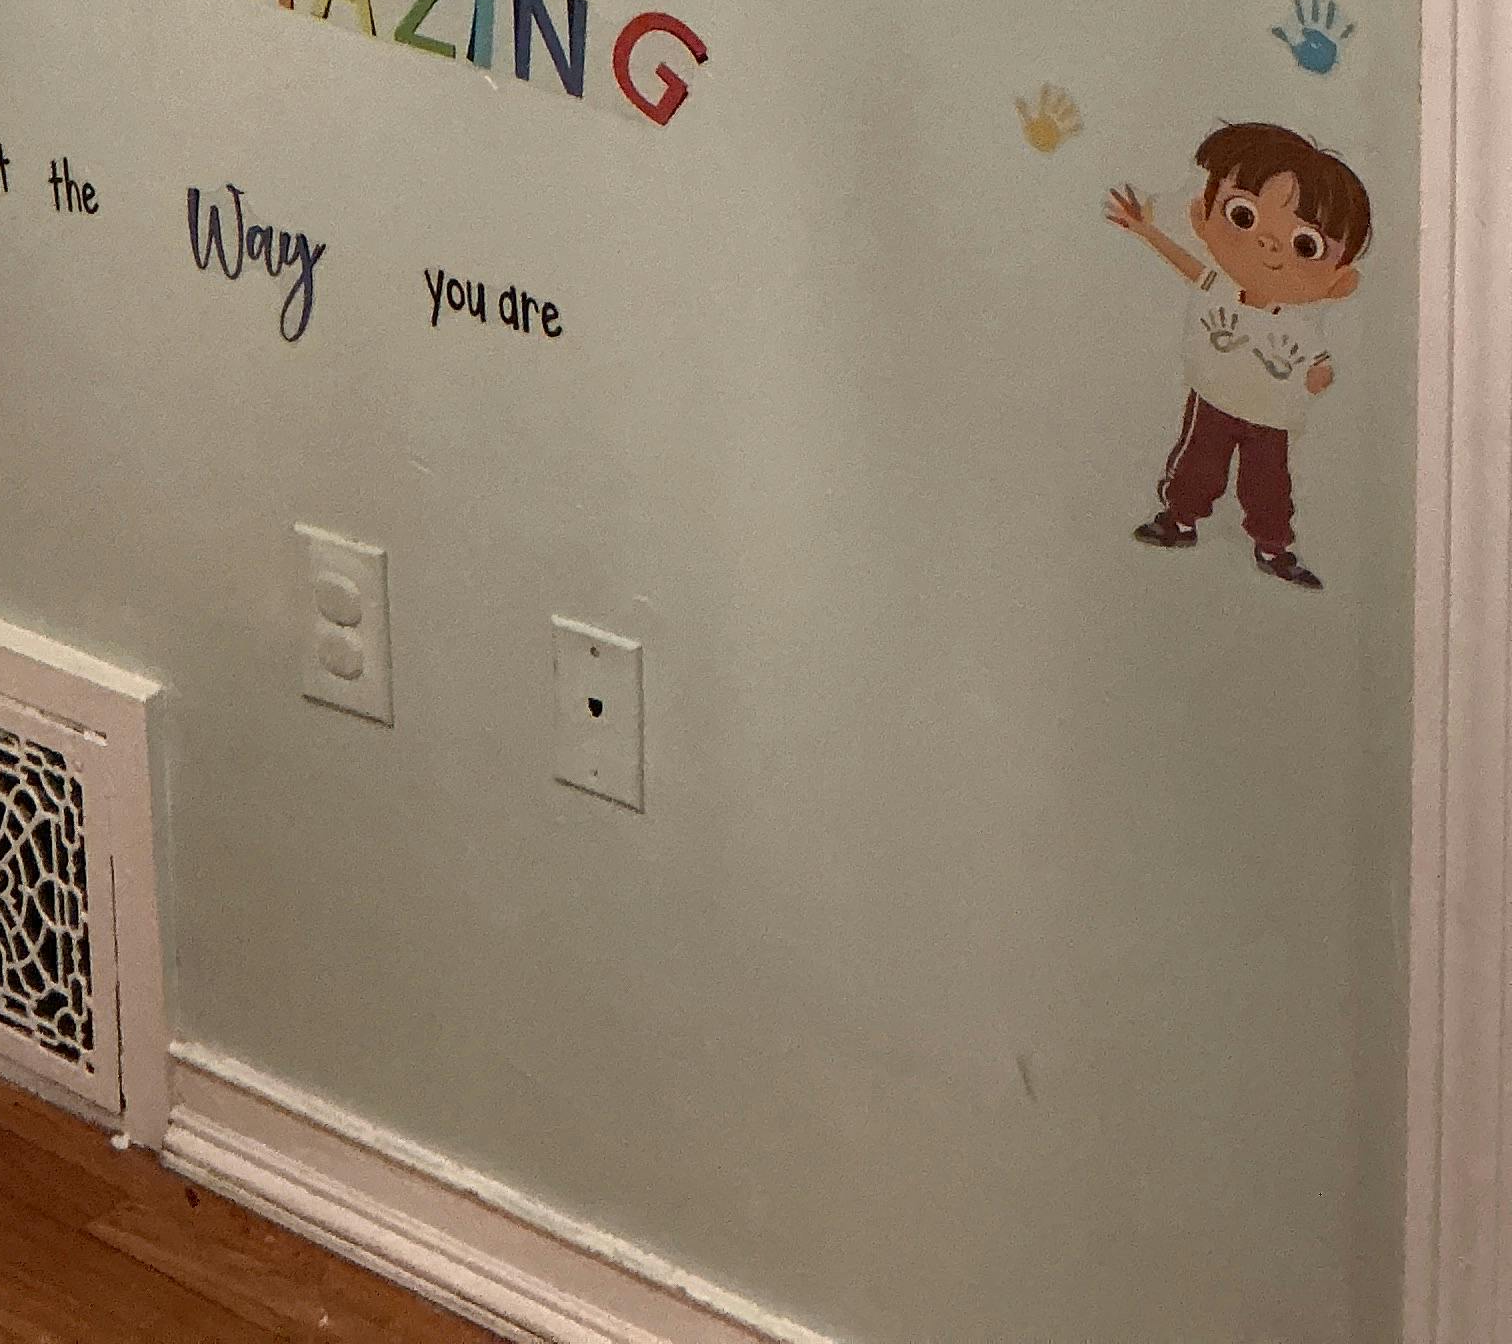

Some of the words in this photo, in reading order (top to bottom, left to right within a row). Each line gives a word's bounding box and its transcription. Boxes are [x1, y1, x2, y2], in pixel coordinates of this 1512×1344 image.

[48, 157, 100, 215] the
[187, 183, 327, 343] Way
[424, 268, 487, 327] you
[498, 285, 564, 338] are
